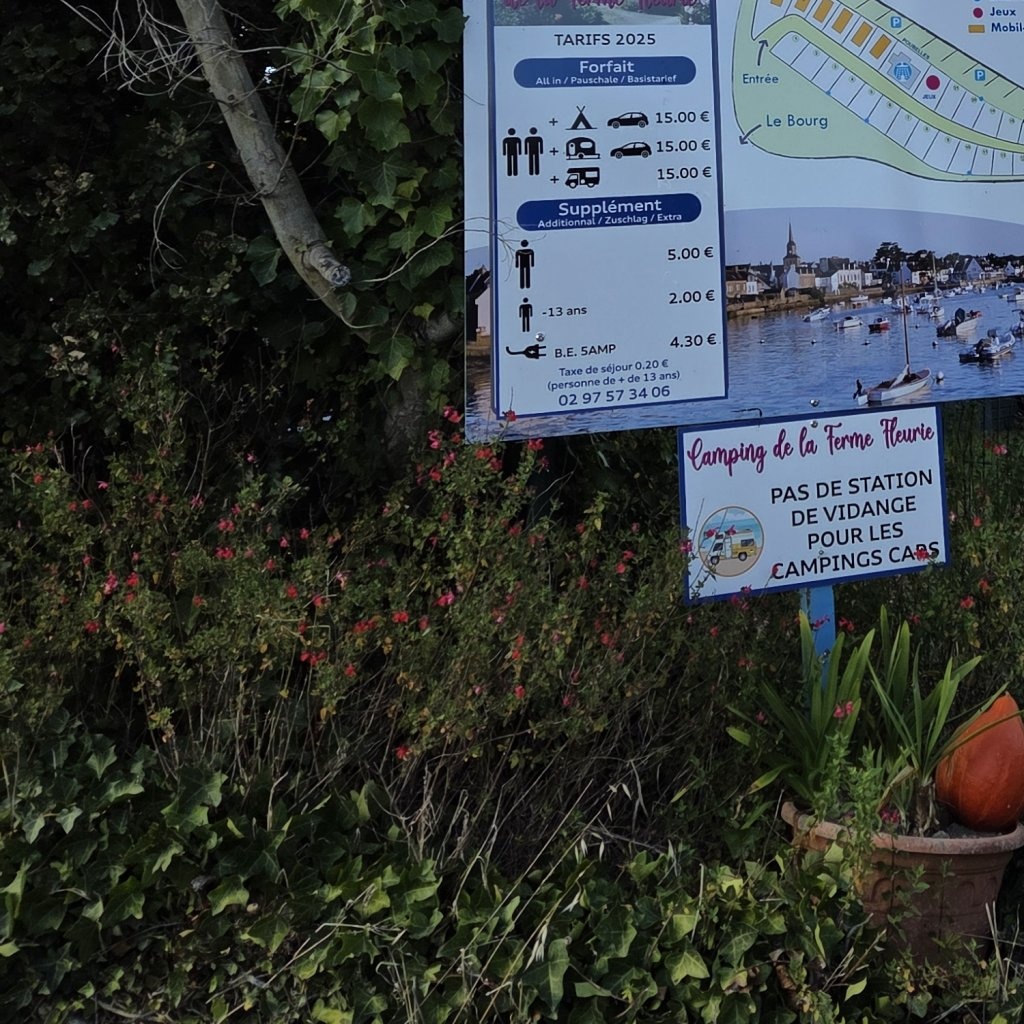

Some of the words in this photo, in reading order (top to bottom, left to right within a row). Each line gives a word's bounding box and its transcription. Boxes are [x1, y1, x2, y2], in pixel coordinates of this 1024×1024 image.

[989, 7, 1017, 18] Jeux
[554, 34, 610, 46] TARIFS
[616, 33, 656, 46] 2025
[579, 60, 635, 74] Forfait
[536, 76, 551, 85] All
[552, 76, 562, 85] in
[570, 75, 619, 84] Pauschale
[627, 74, 678, 83] Basistarief
[742, 73, 779, 85] Entrée
[655, 111, 696, 124] 15.00
[700, 111, 710, 123] €
[766, 115, 784, 127] Le
[787, 114, 828, 129] Bourg
[656, 140, 697, 153] 15.00
[701, 139, 711, 151] €
[657, 167, 699, 180] 15.00
[702, 166, 712, 178] €
[558, 199, 662, 217] Supplément
[537, 217, 596, 228] Additionnal
[605, 214, 648, 225] Zuschlag
[657, 213, 682, 222] Extra
[667, 247, 700, 260] 5.00
[704, 246, 714, 258] €
[669, 291, 701, 304] 2.00
[706, 290, 715, 302] €
[542, 306, 563, 317] -13
[566, 306, 587, 317] ans
[670, 334, 703, 348] 4.30
[707, 333, 717, 345] €
[554, 347, 577, 358] B.E.
[581, 344, 616, 357] 5AMP
[559, 366, 583, 377] Taxe
[585, 365, 599, 375] de
[601, 362, 633, 376] séjour
[635, 360, 659, 370] 0.20
[661, 359, 669, 369] €
[547, 378, 600, 392] (personne
[603, 376, 616, 386] de
[627, 374, 640, 384] de
[643, 372, 656, 382] 13
[659, 370, 680, 381] ans)
[558, 394, 578, 407] 02
[582, 392, 600, 404] 97
[606, 389, 624, 402] 57
[629, 387, 648, 400] 34
[651, 385, 670, 398] 06
[687, 437, 767, 476] Camping
[773, 429, 793, 459] de
[799, 427, 818, 457] la
[824, 423, 874, 455] Ferme
[880, 417, 935, 448] Fleurie
[771, 484, 809, 504] PAS
[816, 480, 842, 498] DE
[848, 469, 933, 494] STATION
[791, 508, 818, 527] DE
[823, 495, 917, 522] VIDANGE
[808, 527, 863, 550] POUR
[869, 522, 903, 541] LES
[771, 550, 883, 579] CAMPINGS
